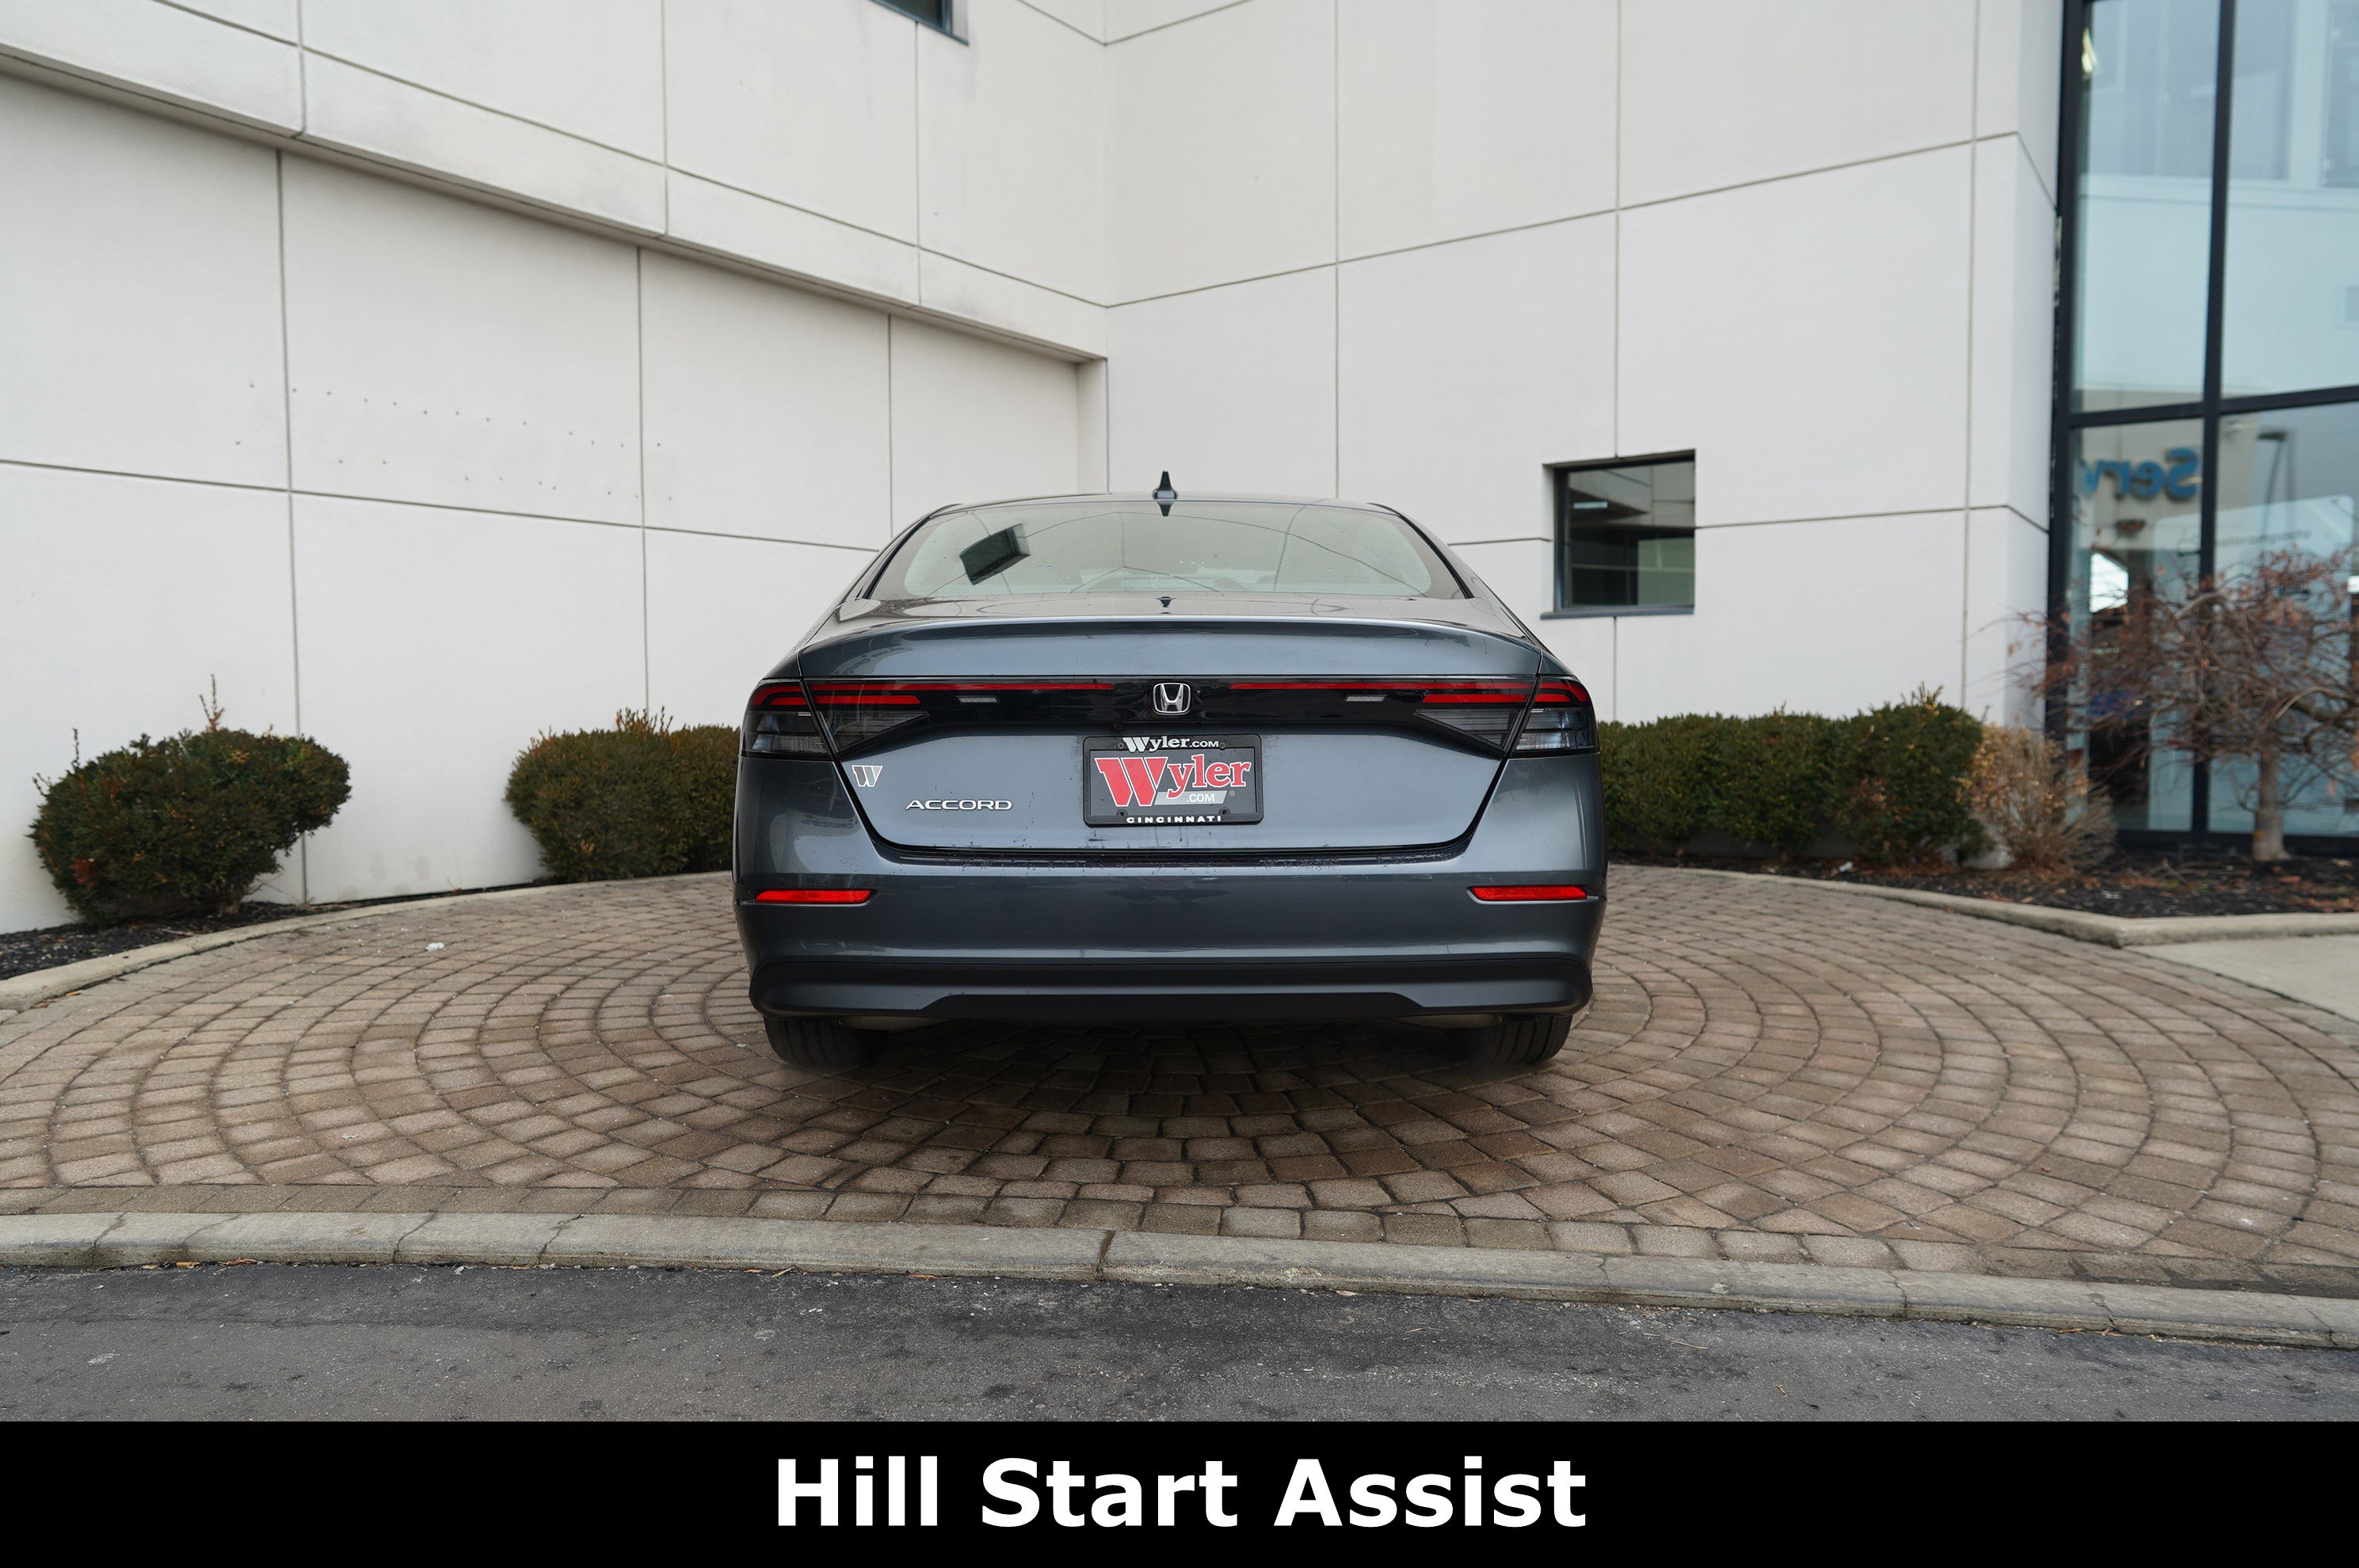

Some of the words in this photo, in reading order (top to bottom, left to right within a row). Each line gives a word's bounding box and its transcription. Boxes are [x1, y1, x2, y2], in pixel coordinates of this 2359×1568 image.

[1094, 753, 1252, 807] Wyler
[1186, 793, 1215, 802] .COM
[905, 799, 1013, 811] ACCORD
[1126, 815, 1222, 824] CINCINNATI
